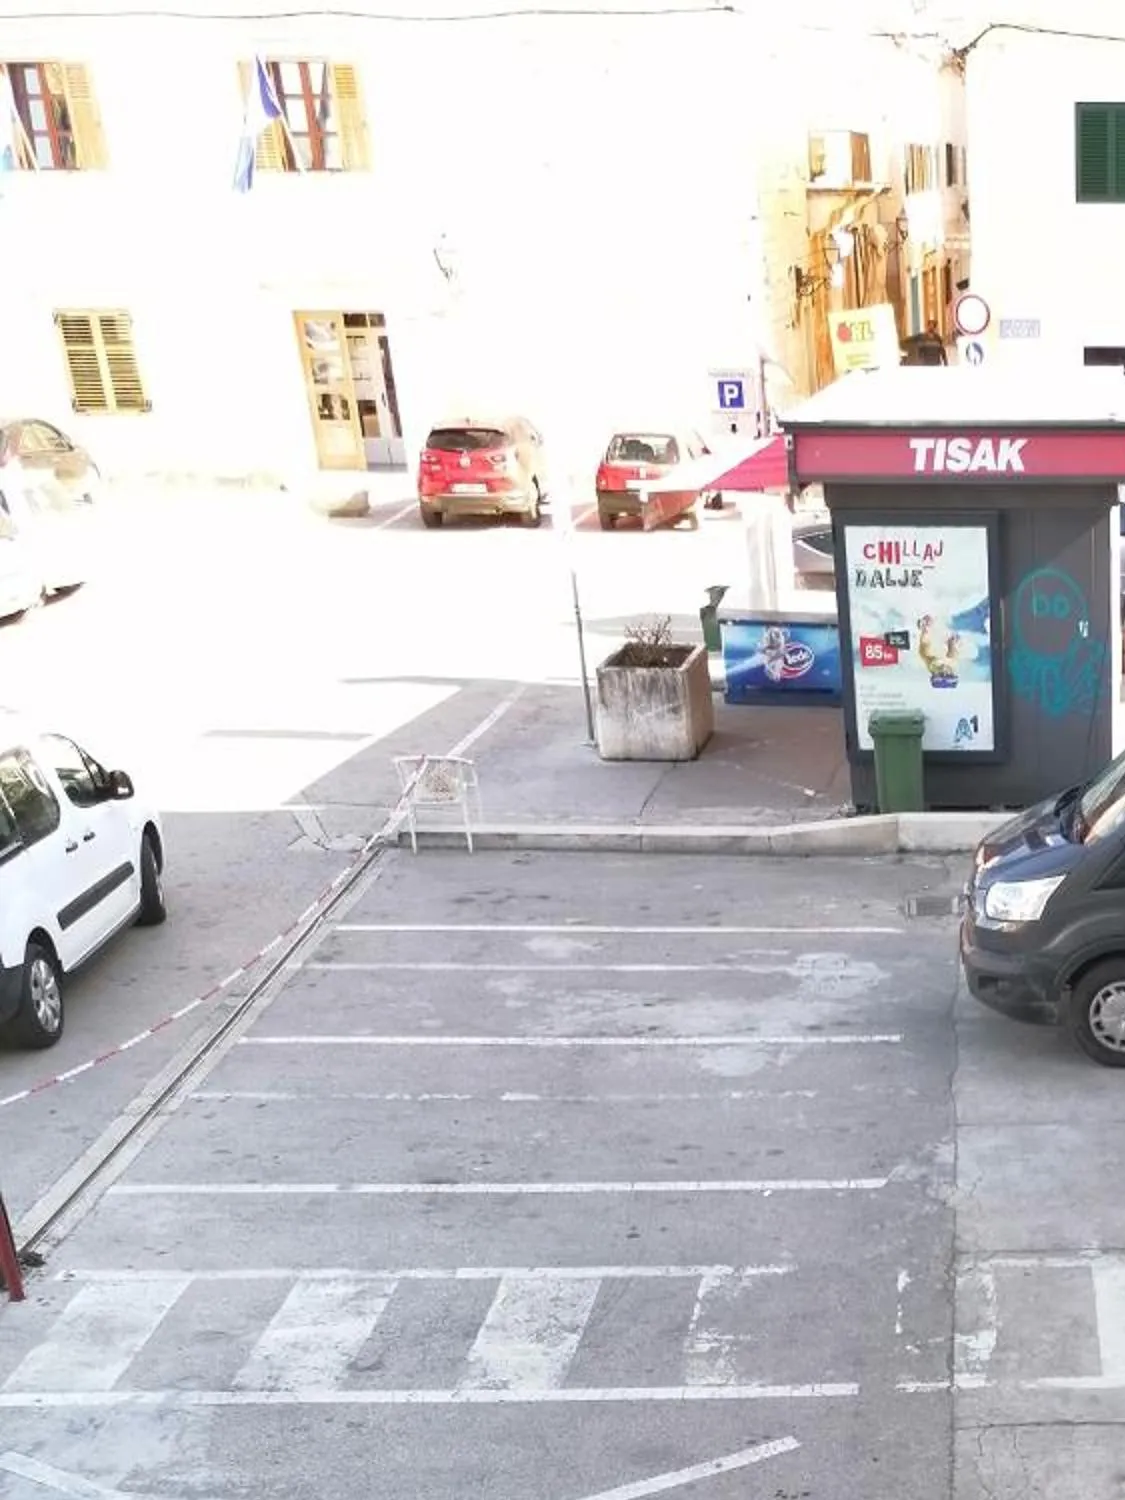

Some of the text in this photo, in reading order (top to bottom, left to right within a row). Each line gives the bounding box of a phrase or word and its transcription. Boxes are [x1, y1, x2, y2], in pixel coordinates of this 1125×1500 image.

[723, 383, 739, 407] P
[908, 436, 1028, 472] TISAK
[862, 539, 943, 565] CHILLAJ
[854, 567, 922, 589] DALJE
